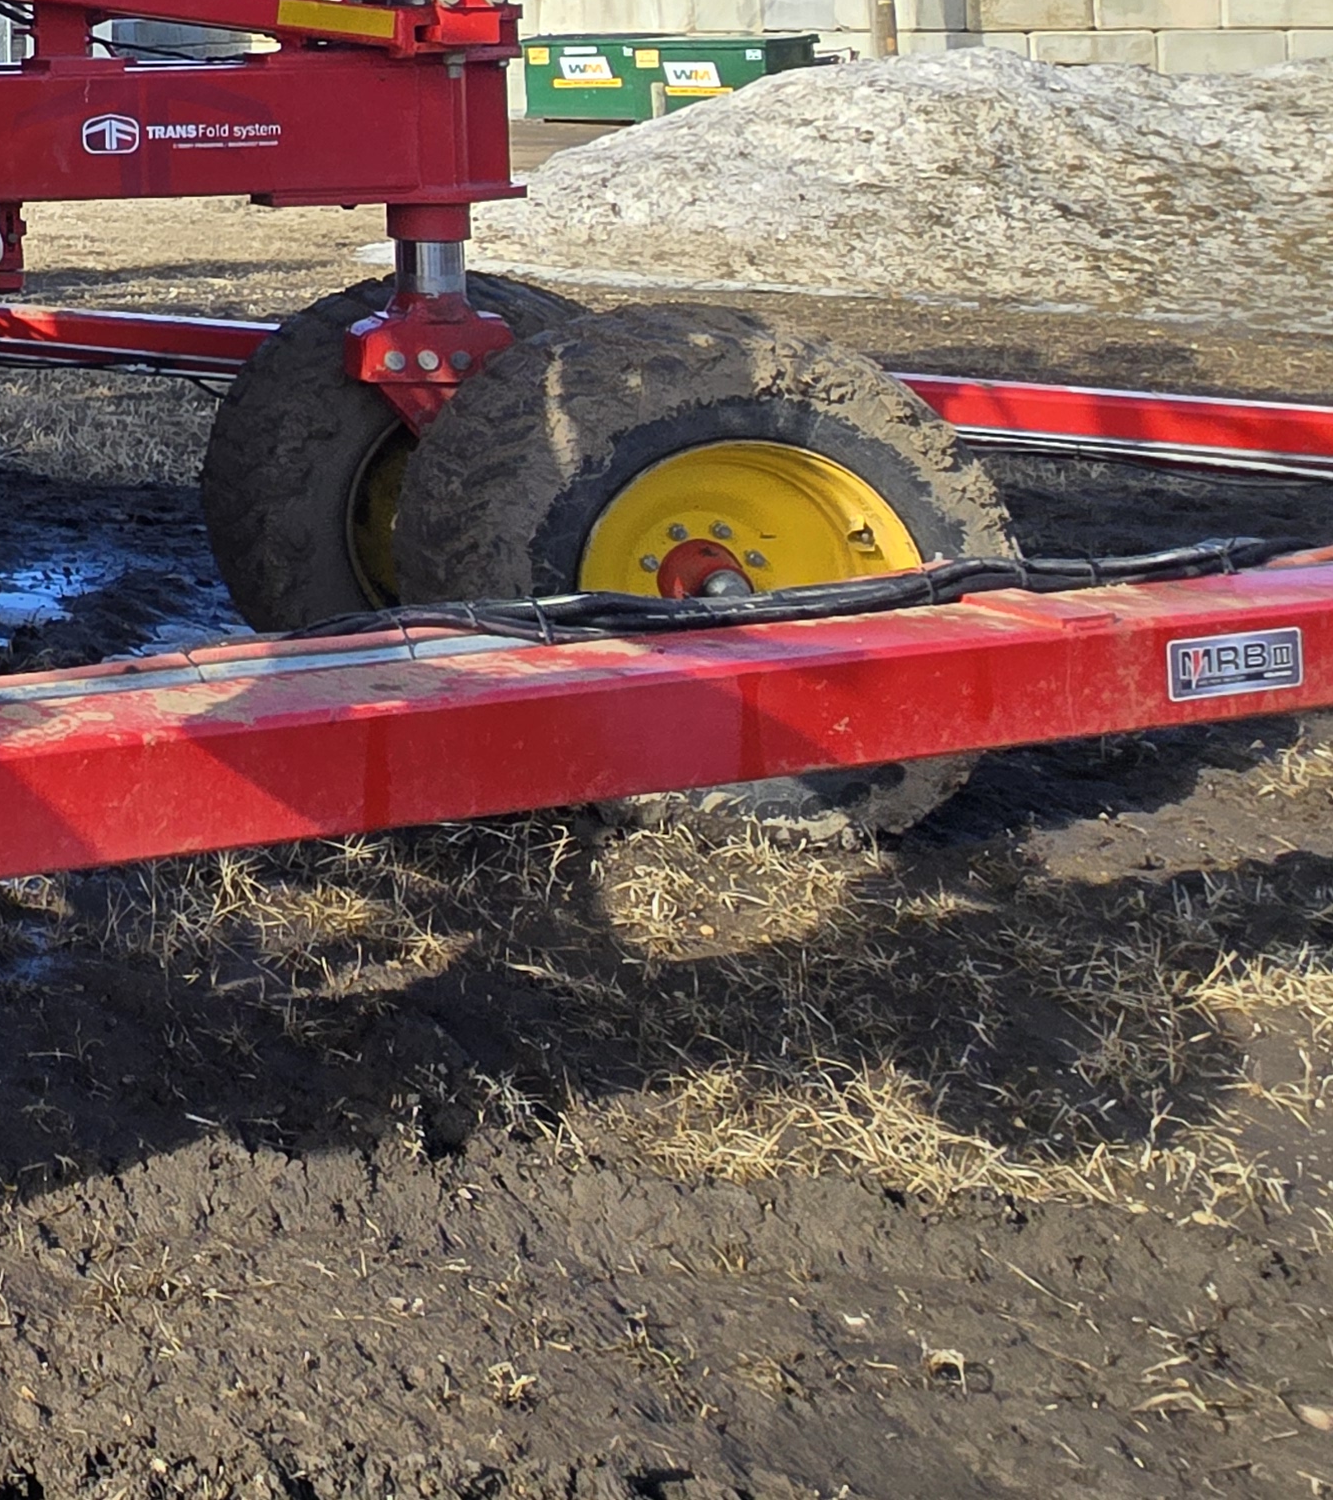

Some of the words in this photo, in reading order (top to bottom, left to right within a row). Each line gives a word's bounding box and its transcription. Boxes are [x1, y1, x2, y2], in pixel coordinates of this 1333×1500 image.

[568, 64, 603, 74] WM
[673, 69, 711, 81] WM
[233, 123, 282, 139] system
[1179, 642, 1268, 680] MRB
